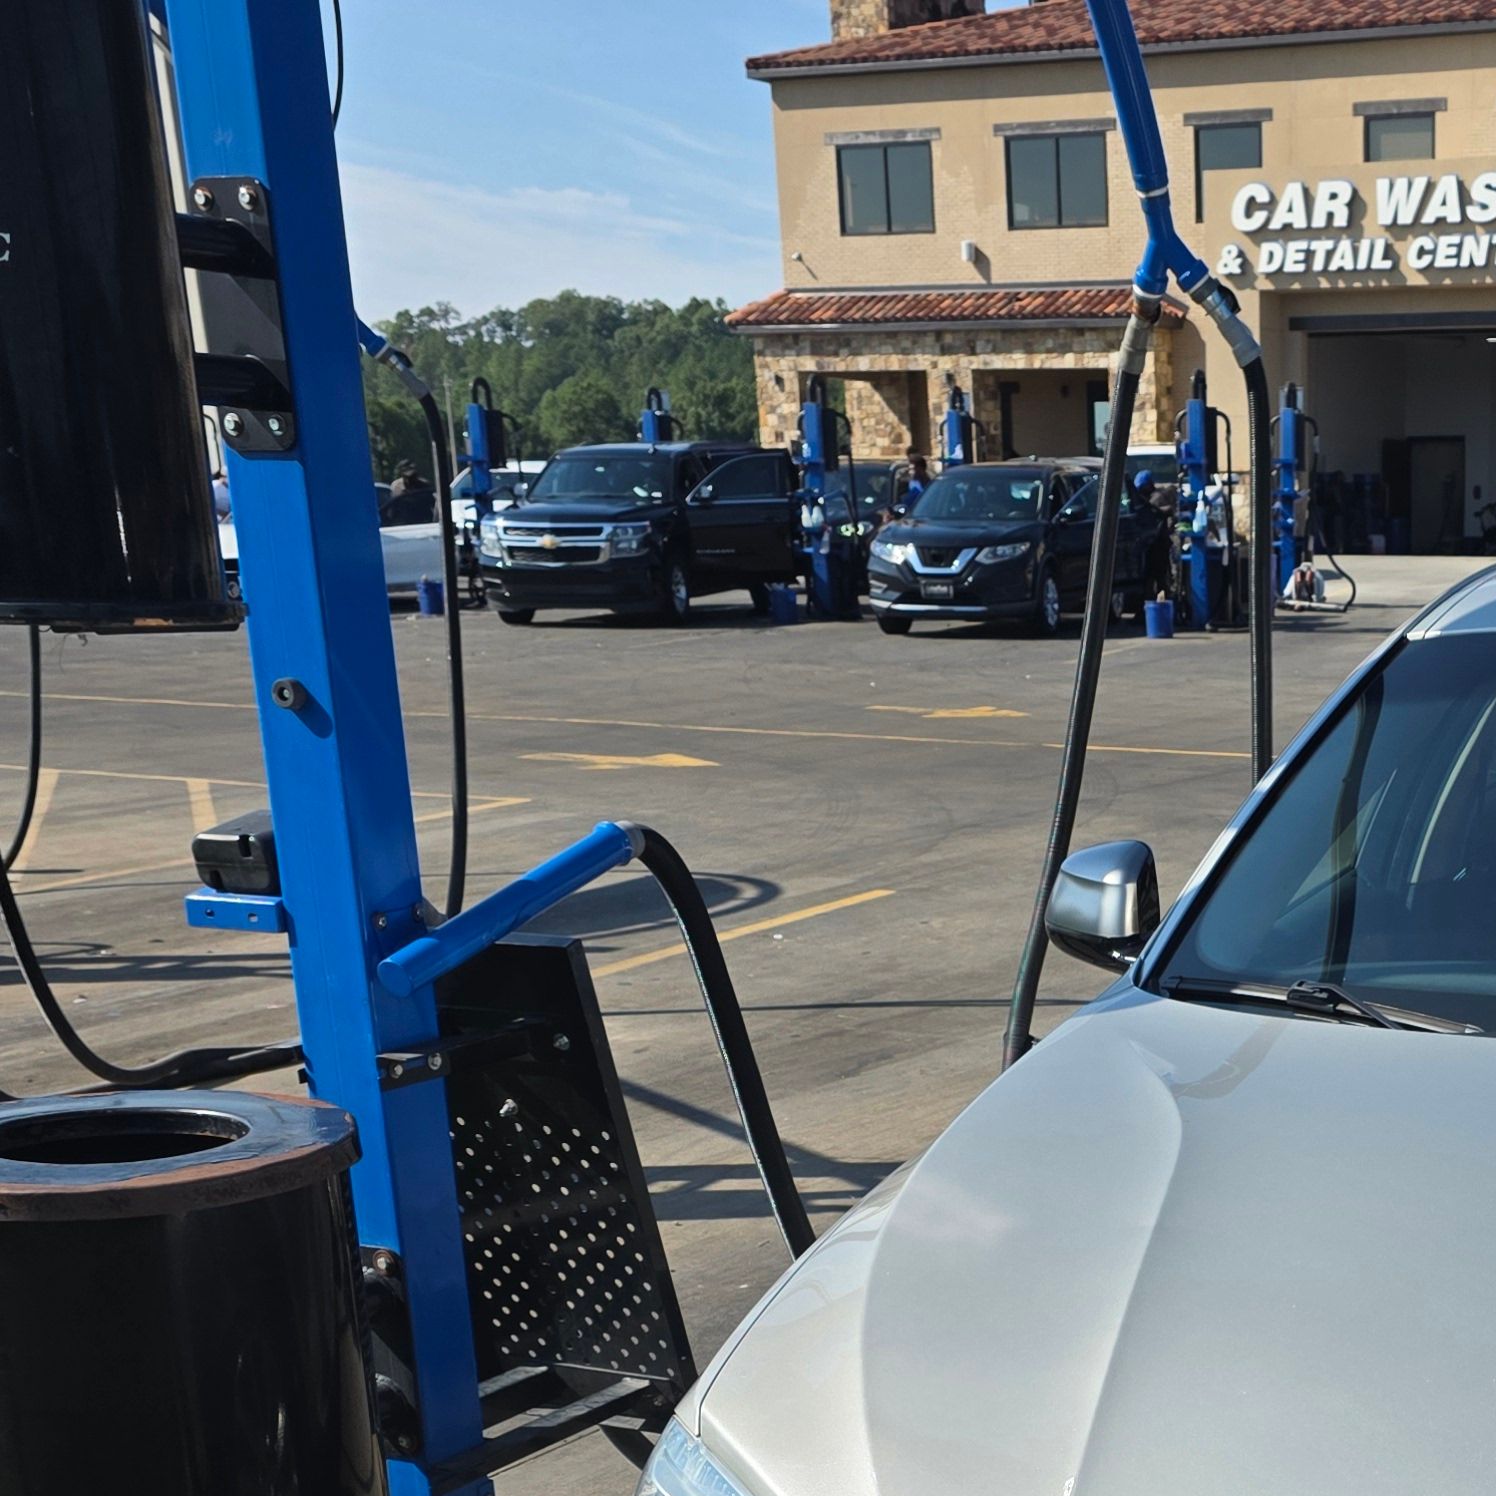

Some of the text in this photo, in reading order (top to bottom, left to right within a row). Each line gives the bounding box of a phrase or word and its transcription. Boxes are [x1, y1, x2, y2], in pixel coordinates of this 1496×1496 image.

[1232, 179, 1354, 232] CAR
[1216, 242, 1245, 276] &
[1257, 236, 1394, 274] DETAIL
